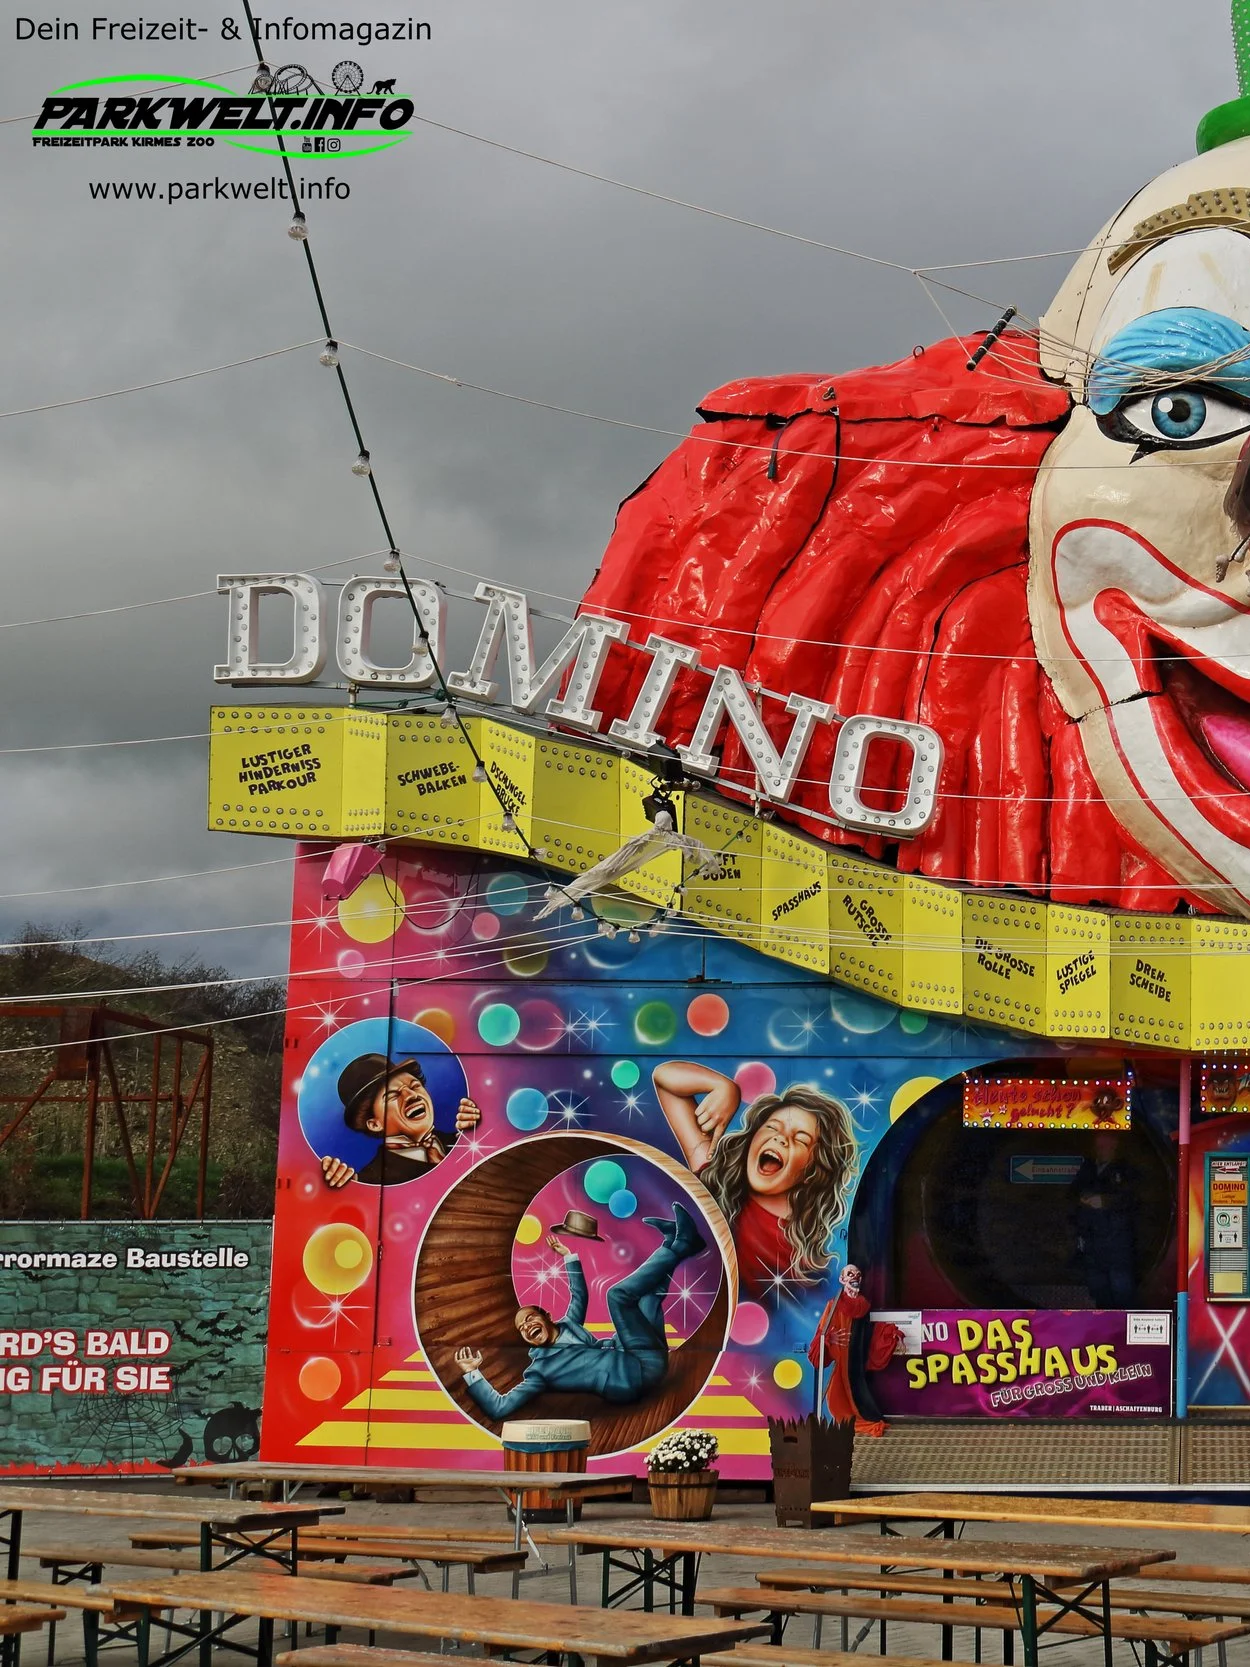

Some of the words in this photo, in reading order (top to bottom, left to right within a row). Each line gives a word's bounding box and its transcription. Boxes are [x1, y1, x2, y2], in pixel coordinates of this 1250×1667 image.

[214, 573, 945, 836] DOMINO
[238, 758, 321, 783] HINDERNISS
[241, 743, 312, 769] LUSTIGER
[249, 771, 316, 796] PARKOUR
[397, 761, 460, 787] SCHWEBE-
[416, 774, 467, 797] BALKEN
[771, 881, 823, 921] SPASSHAUS
[860, 899, 893, 944] GROSSE
[976, 952, 1011, 980] ROLLE
[994, 947, 1036, 977] GROSSE
[1056, 950, 1096, 980] LUSTIGE
[1135, 958, 1168, 983] DREH-
[1059, 964, 1097, 995] SPIEGEL
[1128, 973, 1172, 1003] SCHEIBE
[1212, 1183, 1246, 1191] DOMINO
[0, 1252, 118, 1268] rormaze
[126, 1248, 249, 1268] Baustelle
[87, 1331, 170, 1356] BALD
[957, 1318, 1033, 1351] DAS
[41, 1360, 105, 1391] FÜR
[116, 1366, 171, 1391] SIE
[906, 1343, 1119, 1390] SPASSHAUS
[991, 1384, 1023, 1408] FÜR
[1023, 1377, 1073, 1400] GROSS
[1074, 1370, 1107, 1390] UND
[1108, 1362, 1153, 1385] KLEIN
[1115, 1405, 1163, 1413] ASCHAFFENBURG
